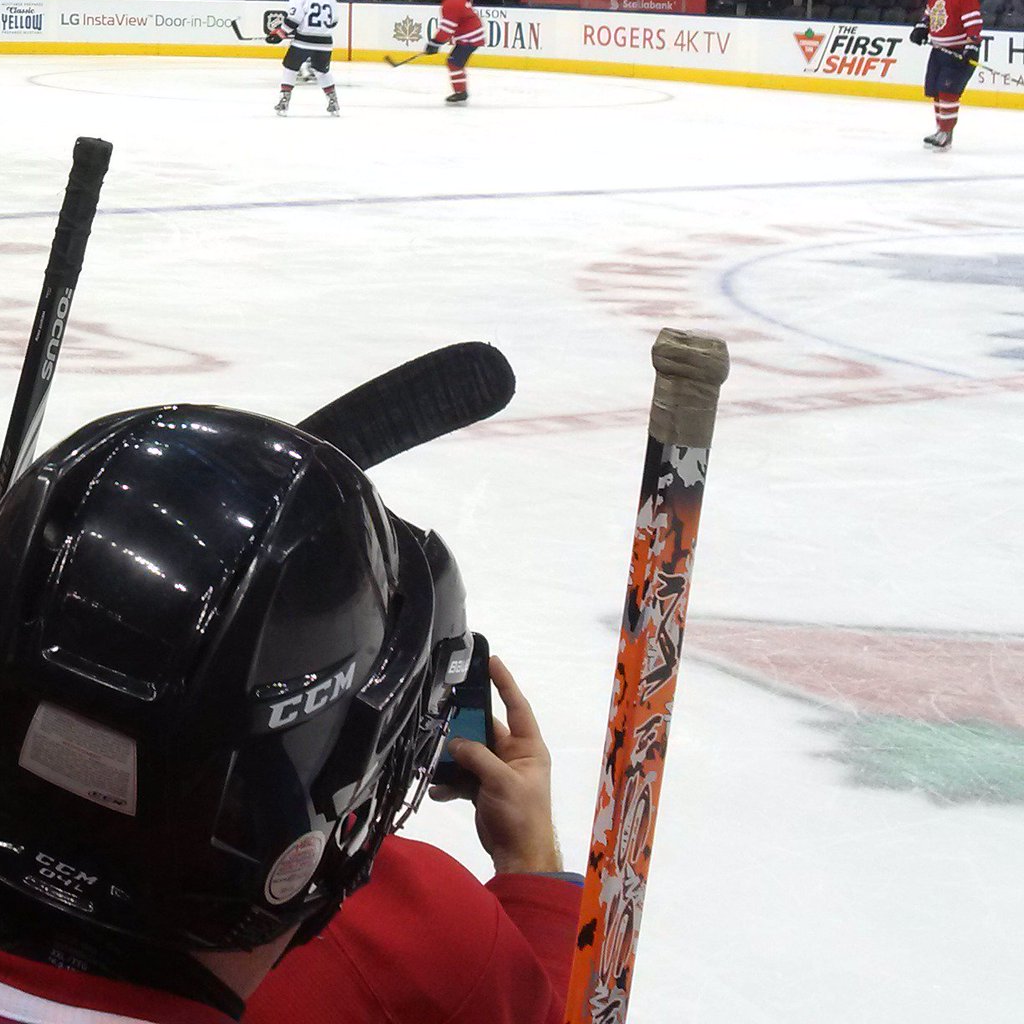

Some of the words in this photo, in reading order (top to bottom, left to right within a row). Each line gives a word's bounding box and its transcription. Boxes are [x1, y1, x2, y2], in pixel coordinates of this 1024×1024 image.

[6, 6, 35, 14] Classic
[61, 13, 79, 26] LG
[308, 2, 338, 29] 23
[476, 9, 507, 20] LSON
[1, 13, 43, 31] YELLOW
[838, 25, 858, 34] THE
[427, 17, 542, 51] CDIAN
[583, 24, 666, 51] ROGERS
[830, 36, 903, 57] FIRST
[822, 55, 897, 78] SHIFT
[268, 661, 356, 729] CCM
[35, 852, 98, 886] CCM
